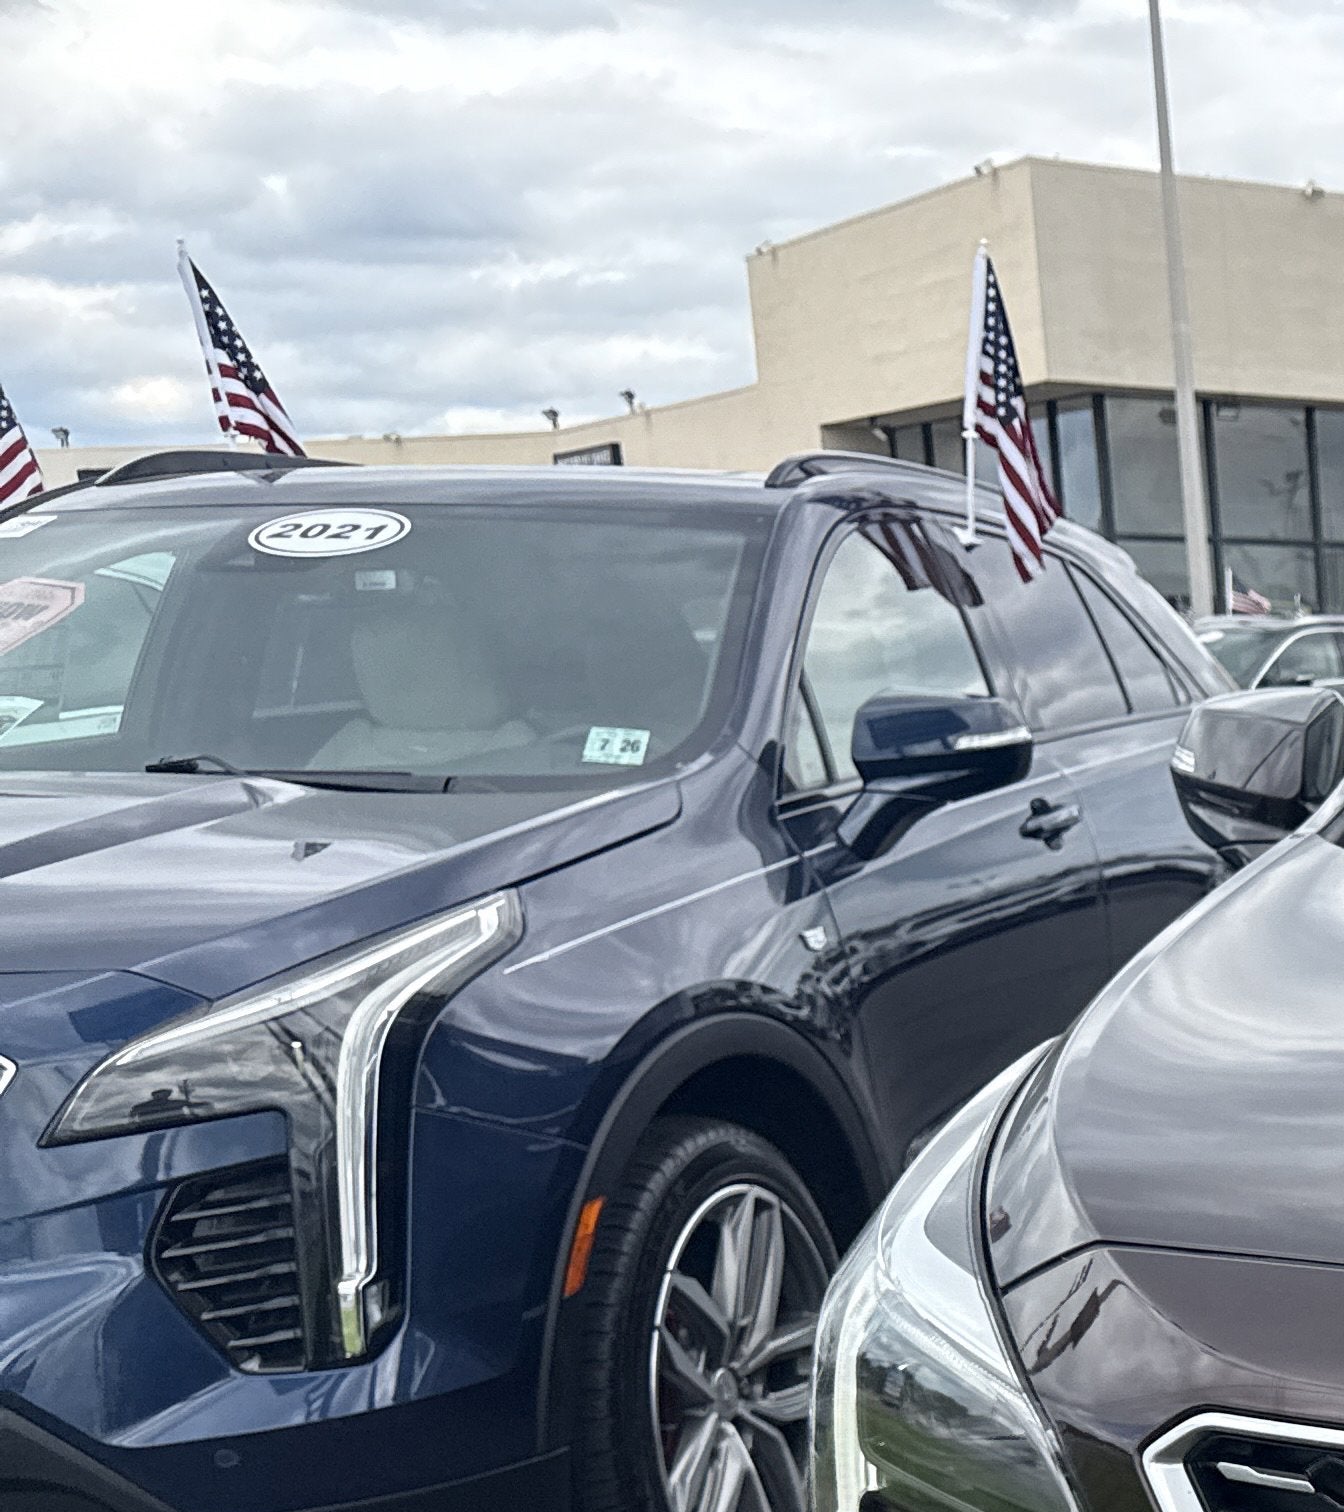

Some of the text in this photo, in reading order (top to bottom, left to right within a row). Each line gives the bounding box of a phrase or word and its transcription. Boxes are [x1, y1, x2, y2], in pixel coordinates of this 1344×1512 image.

[269, 522, 389, 543] 2021
[0, 602, 50, 621] OW
[600, 738, 610, 751] 7
